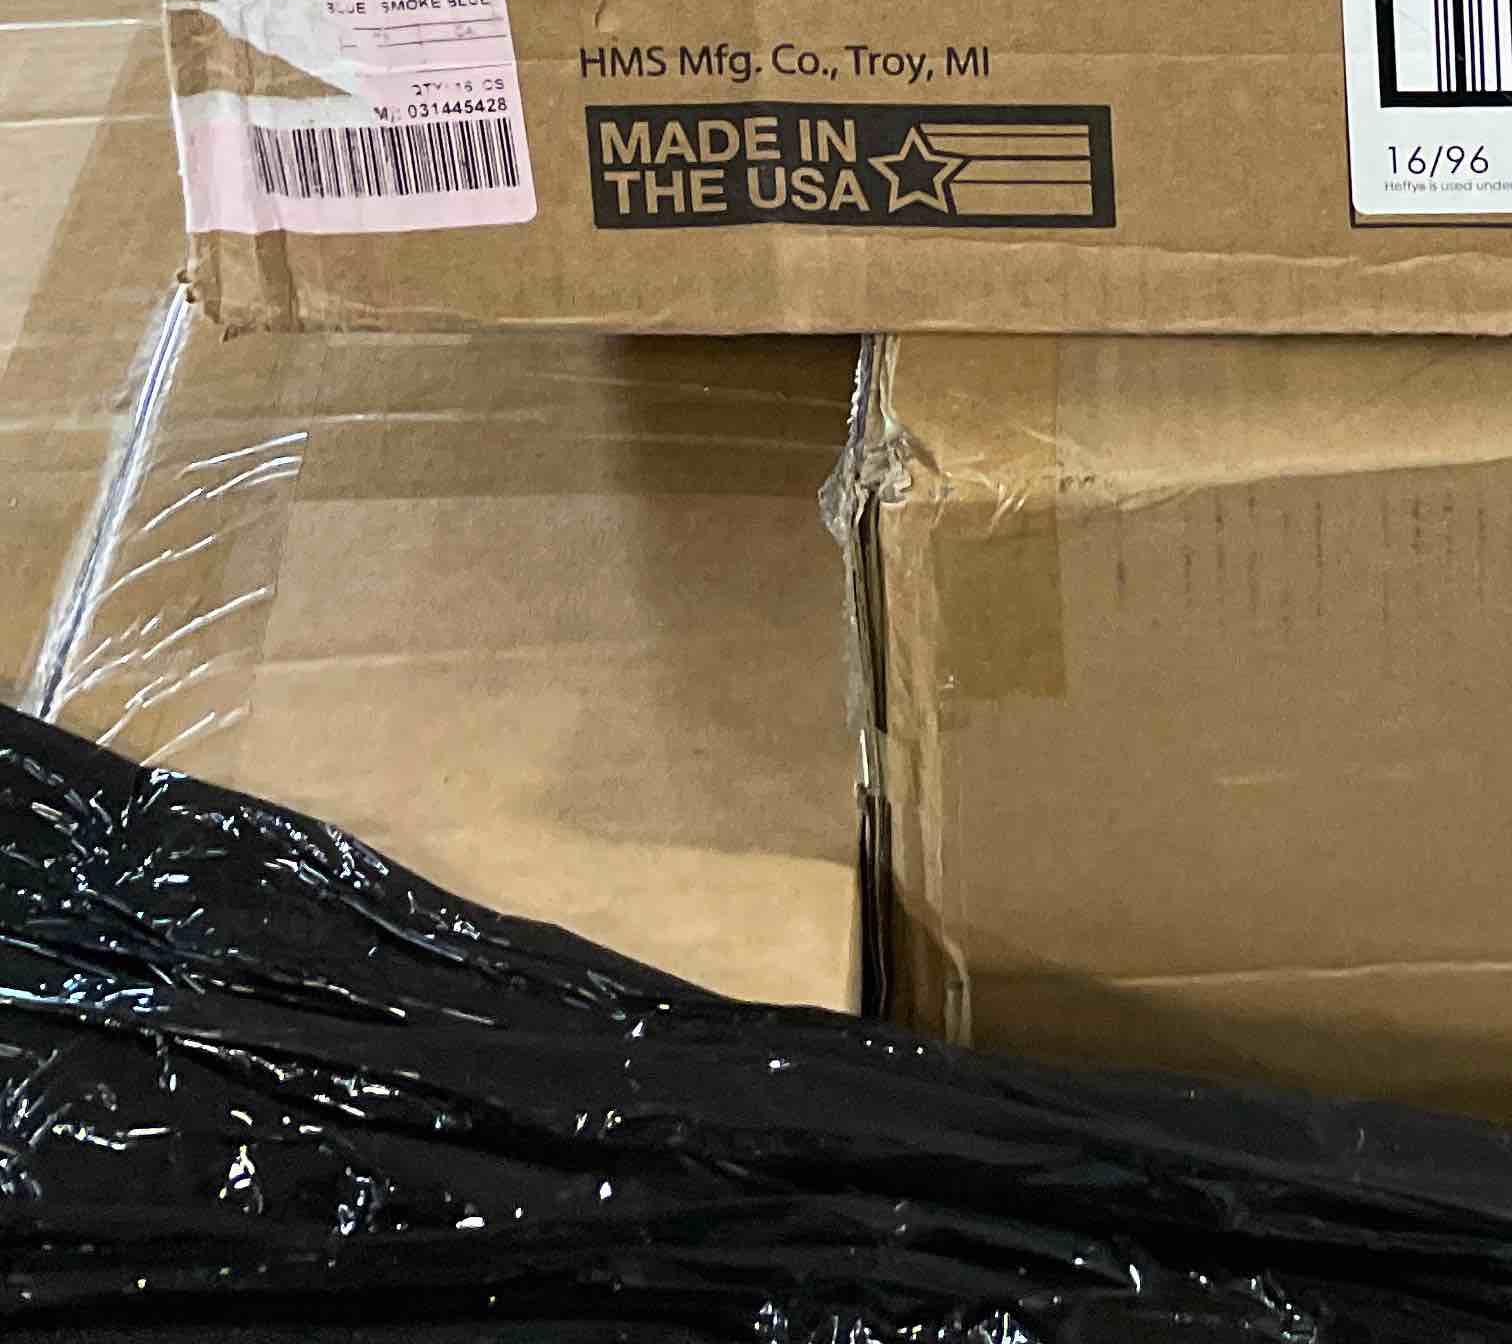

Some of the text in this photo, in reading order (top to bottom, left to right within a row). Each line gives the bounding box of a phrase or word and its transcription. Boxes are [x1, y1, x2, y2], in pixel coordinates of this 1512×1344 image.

[580, 44, 990, 84] HMS Mfg. Co., Troy, MI
[408, 97, 508, 118] 031445428
[601, 117, 857, 167] MADE IN
[1388, 145, 1490, 179] 16/96
[605, 167, 870, 215] THE USA
